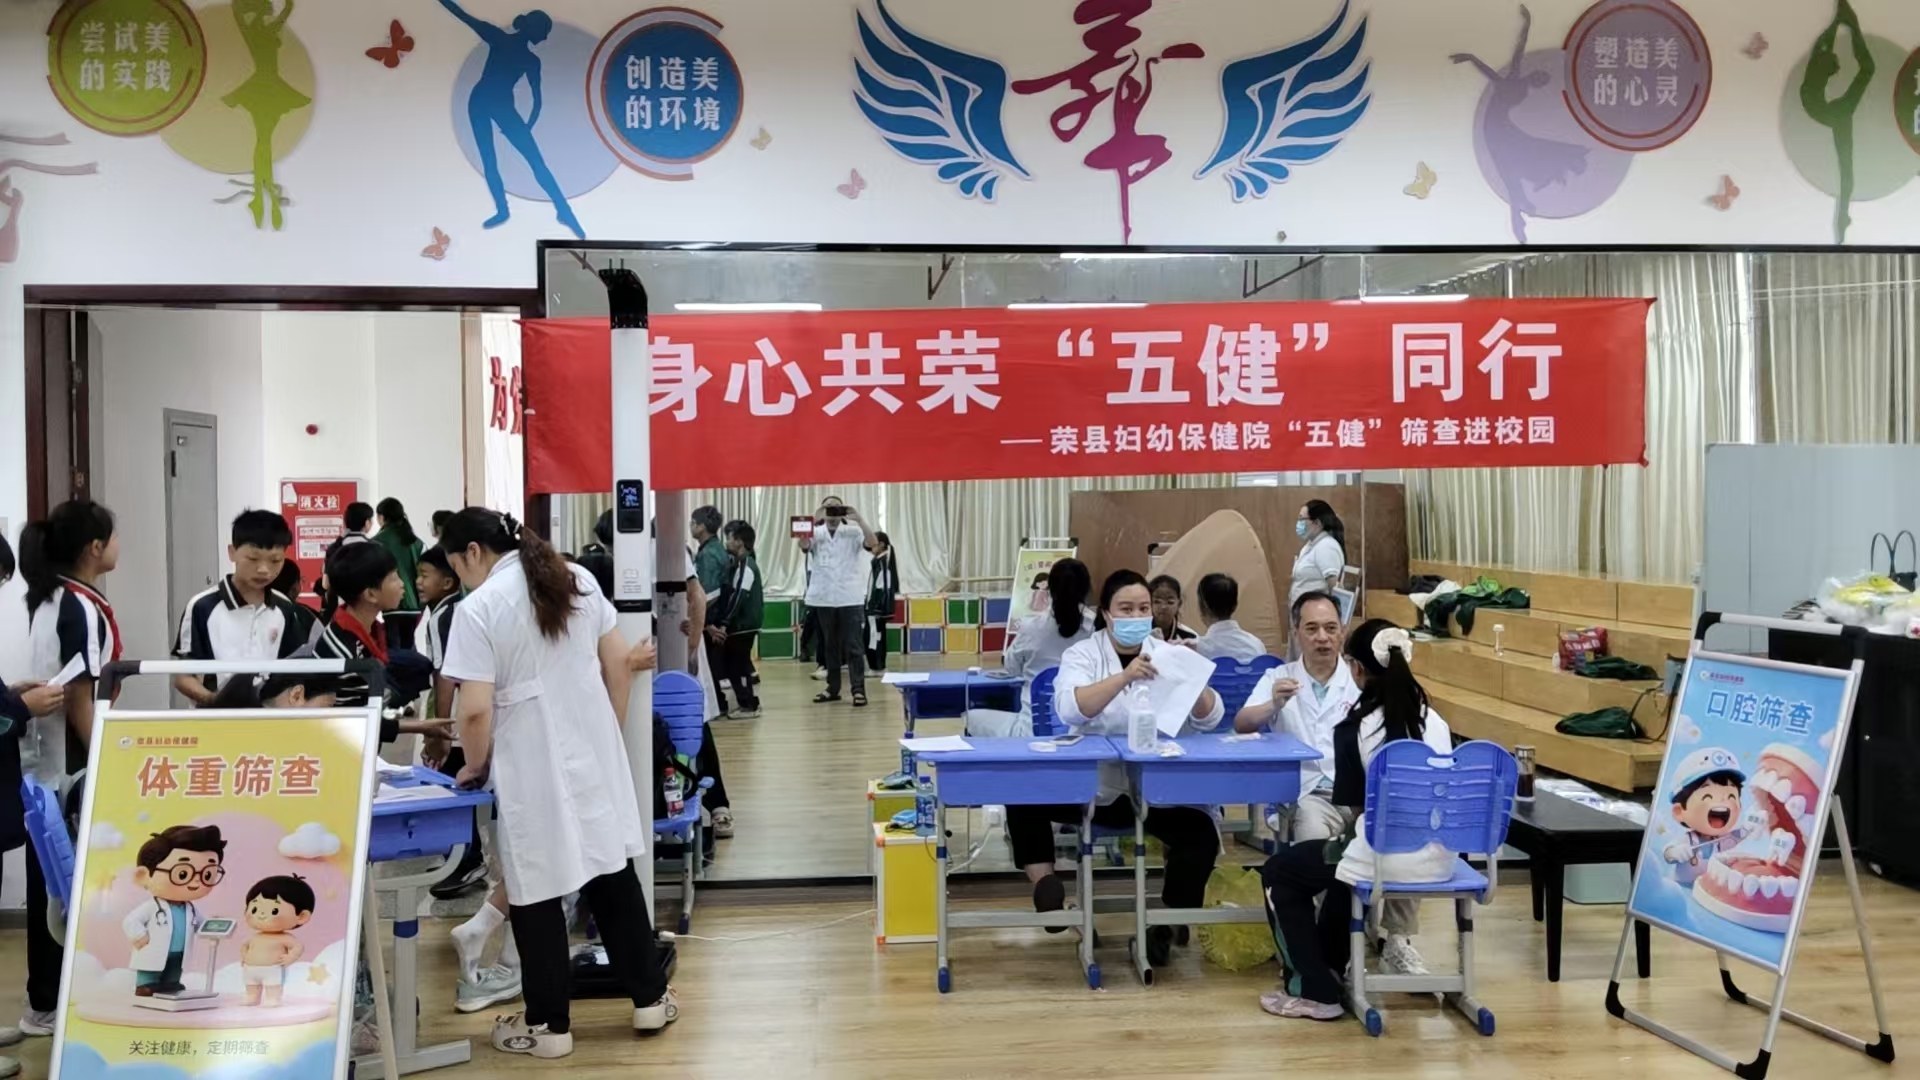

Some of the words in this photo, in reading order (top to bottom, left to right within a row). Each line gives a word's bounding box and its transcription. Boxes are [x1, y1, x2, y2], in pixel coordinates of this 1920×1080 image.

[80, 20, 172, 54] 尝试美
[1594, 36, 1680, 70] 塑造美
[80, 58, 172, 92] 的实践
[626, 54, 720, 91] 创造美
[1593, 73, 1679, 107] 的心灵
[626, 95, 721, 131] 的环境
[300, 494, 338, 510] 消火栓
[1706, 690, 1814, 735] 口腔筛查
[137, 754, 321, 797] 体重筛查
